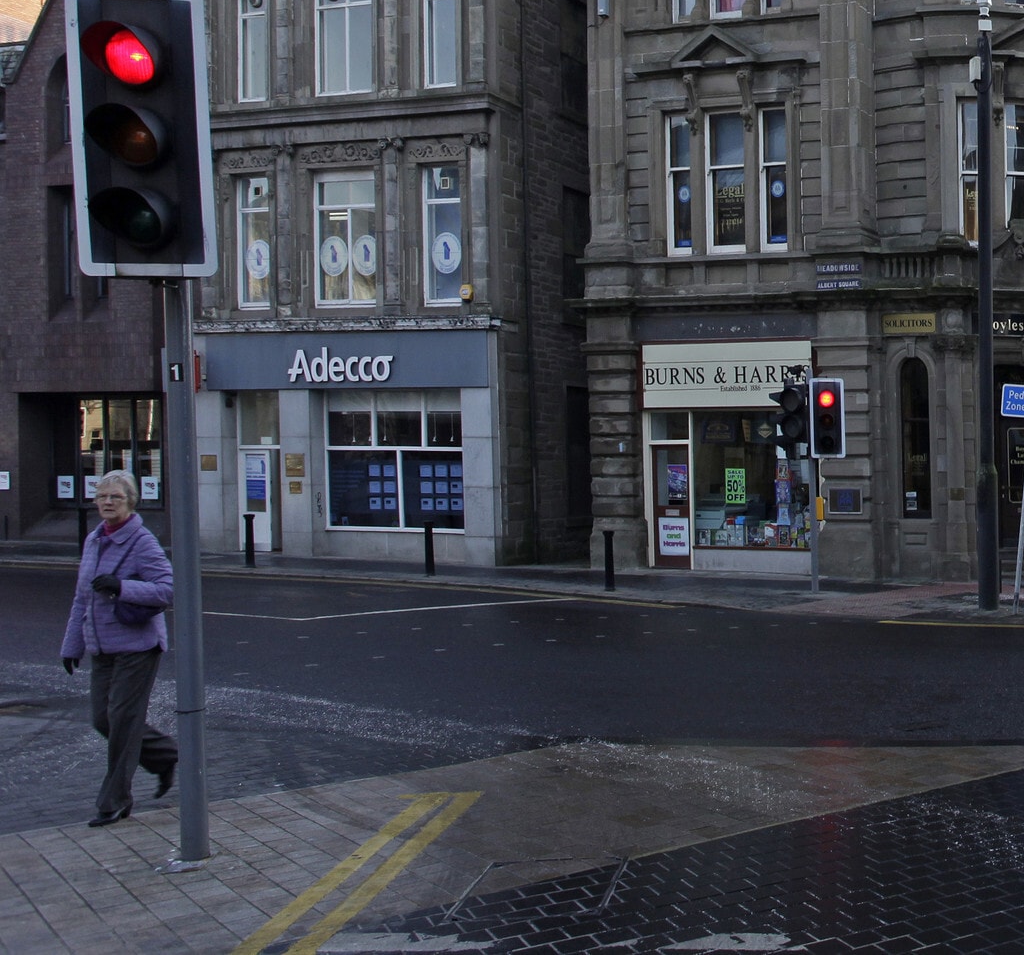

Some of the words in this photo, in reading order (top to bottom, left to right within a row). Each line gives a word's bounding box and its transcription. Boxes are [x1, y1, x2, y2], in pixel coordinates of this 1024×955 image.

[816, 264, 859, 272] MEADOWSIDE
[838, 280, 859, 288] SQUARE
[884, 318, 933, 328] SOLICITORS
[993, 319, 1024, 335] oyles
[287, 347, 394, 383] Adecco
[170, 364, 180, 381] 1
[645, 367, 705, 386] BURNS
[714, 366, 727, 384] &
[727, 479, 745, 493] 50%
[663, 540, 686, 548] Harris
